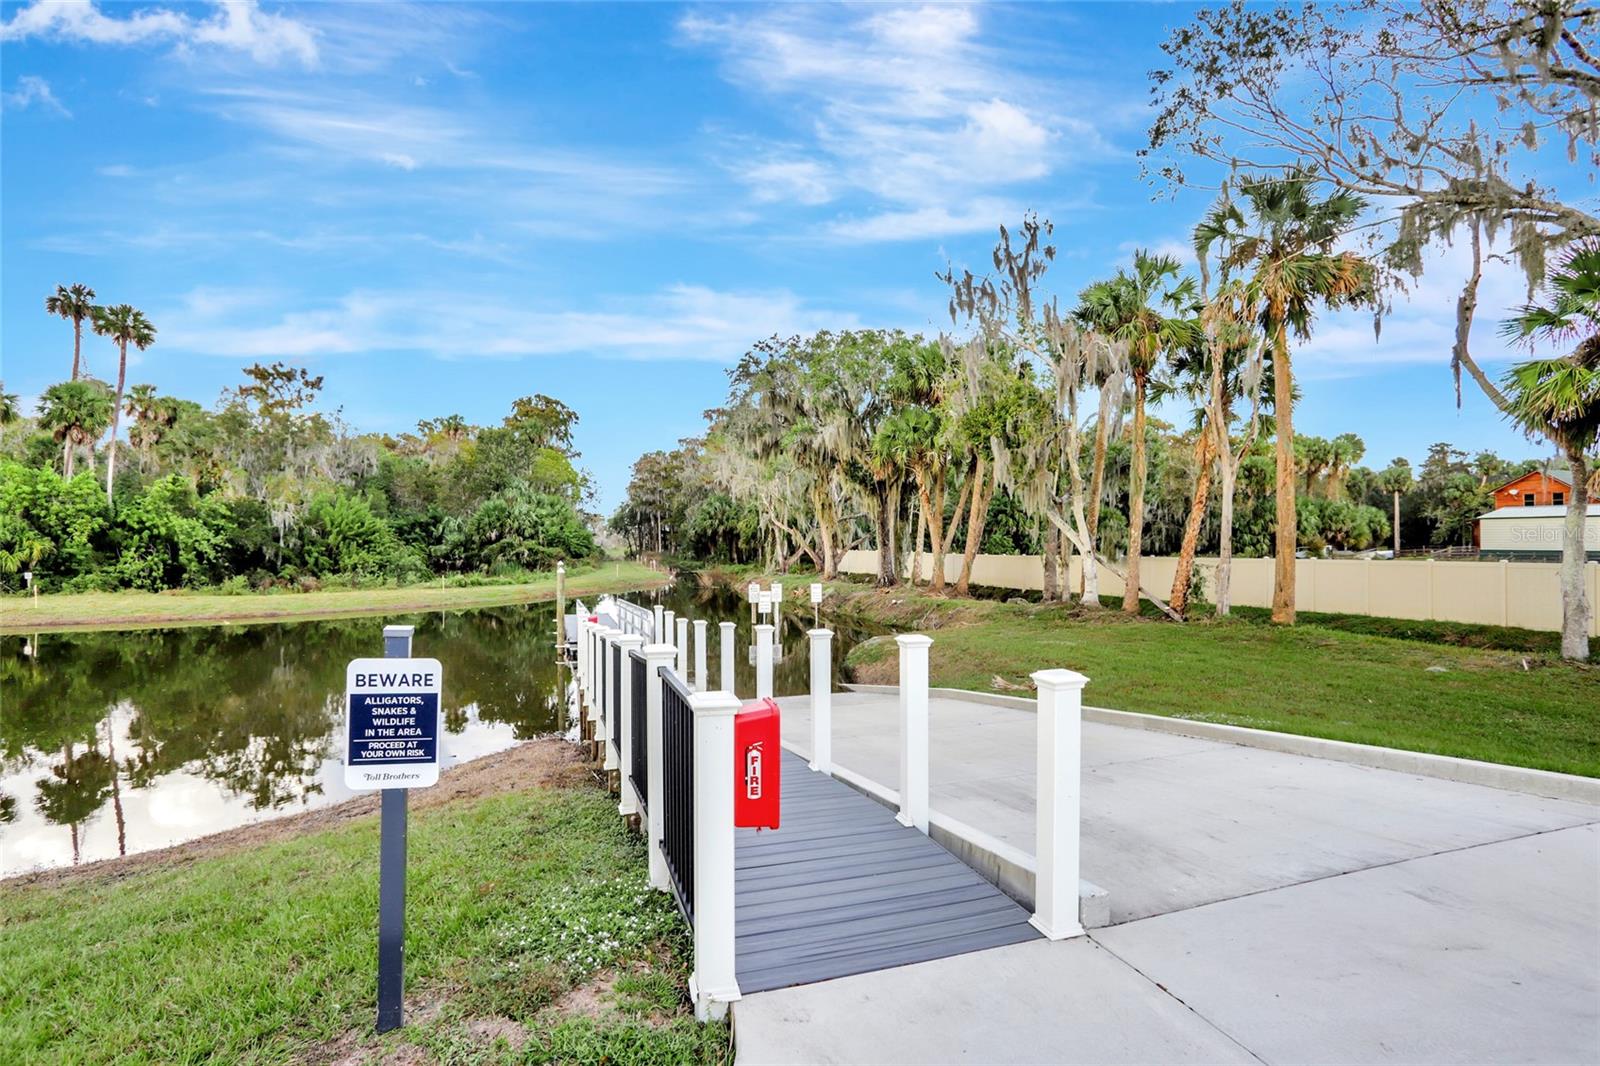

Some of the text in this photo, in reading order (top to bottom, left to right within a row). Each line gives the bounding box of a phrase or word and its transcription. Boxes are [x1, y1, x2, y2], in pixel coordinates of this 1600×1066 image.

[355, 673, 434, 687] BEWARE
[364, 696, 424, 705] ALLIGATORS,
[371, 707, 417, 715] SNAKES &
[372, 717, 416, 726] WILDLIFE
[364, 727, 422, 737] IN THE AREA
[368, 741, 418, 750] PROCEED AT
[361, 750, 384, 758] YOUR
[406, 749, 425, 757] RISK
[363, 772, 420, 781] Toll Brothers
[750, 755, 760, 796] FIRE
